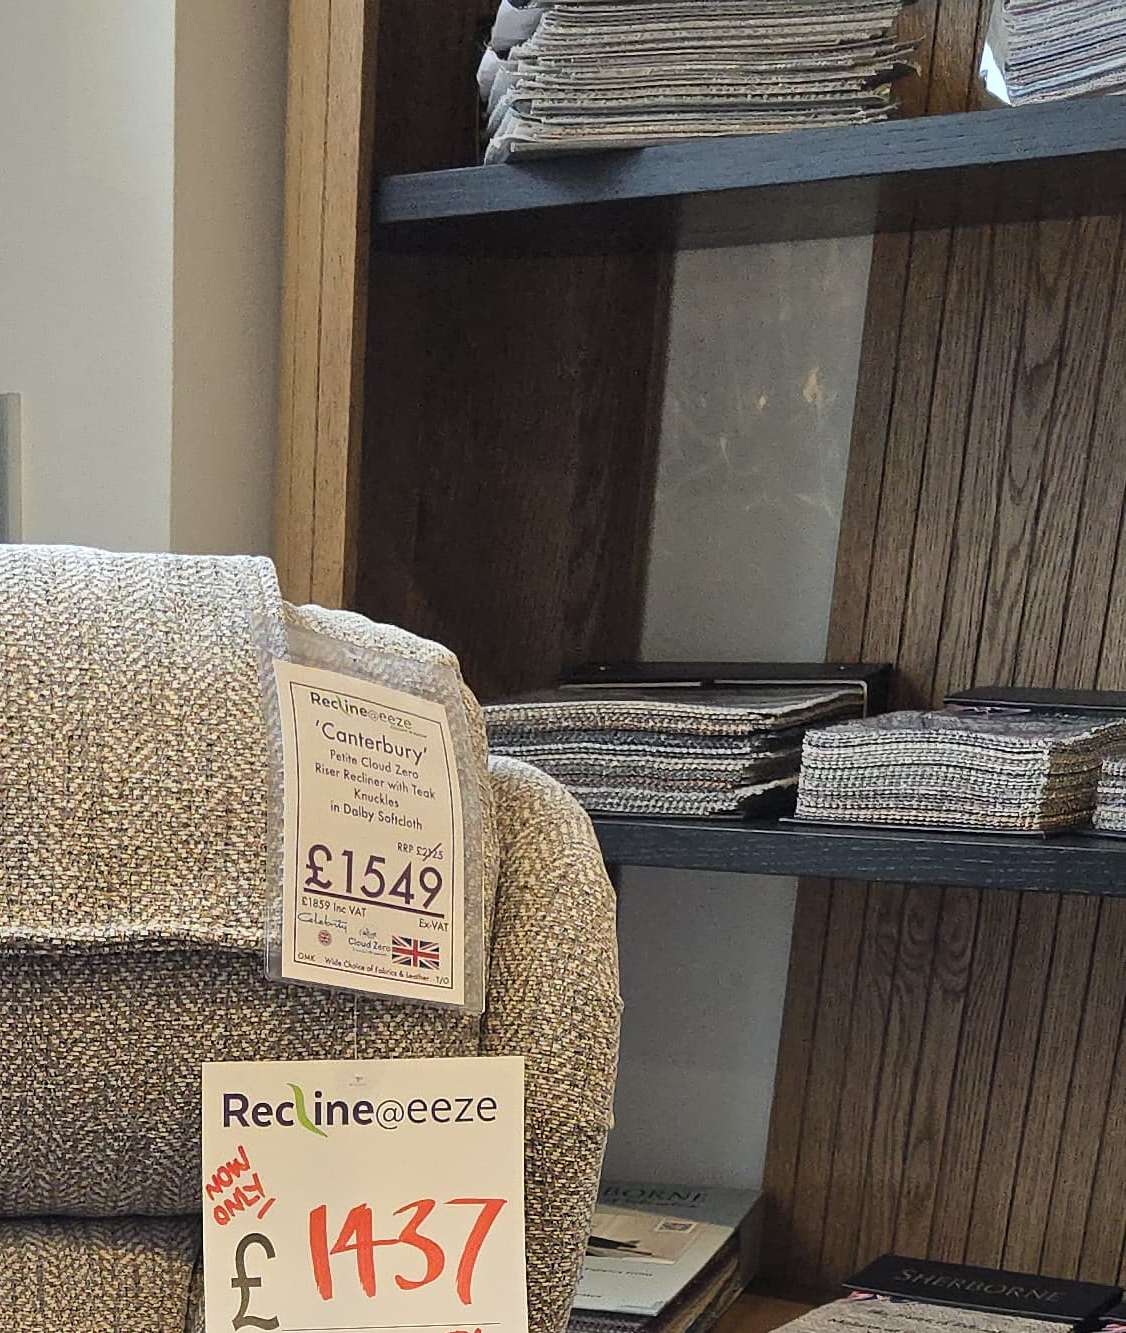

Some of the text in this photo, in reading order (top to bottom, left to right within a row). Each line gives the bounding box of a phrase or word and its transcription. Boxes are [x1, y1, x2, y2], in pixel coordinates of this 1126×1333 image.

[315, 720, 427, 766] 'Canterbury'
[330, 749, 418, 779] Petite Cloud Zero
[315, 762, 436, 800] Riser Recliner with Teak
[354, 788, 399, 808] Knuckles
[330, 800, 423, 830] in Dalby Softcloth
[397, 842, 414, 853] RRP
[304, 844, 443, 909] £1549
[301, 897, 367, 917] £1859 Inc VAT
[297, 912, 348, 934] Celebrity
[348, 937, 372, 949] Cloud
[373, 941, 391, 952] Zero
[324, 957, 341, 967] Wide
[343, 960, 365, 971] Choice
[366, 964, 374, 972] of
[374, 965, 398, 977] Fabrics
[205, 1145, 251, 1200] NOW
[213, 1173, 266, 1226] ONLY
[231, 1199, 508, 1333] £ 1437
[893, 1269, 1067, 1301] SHERBORNE
